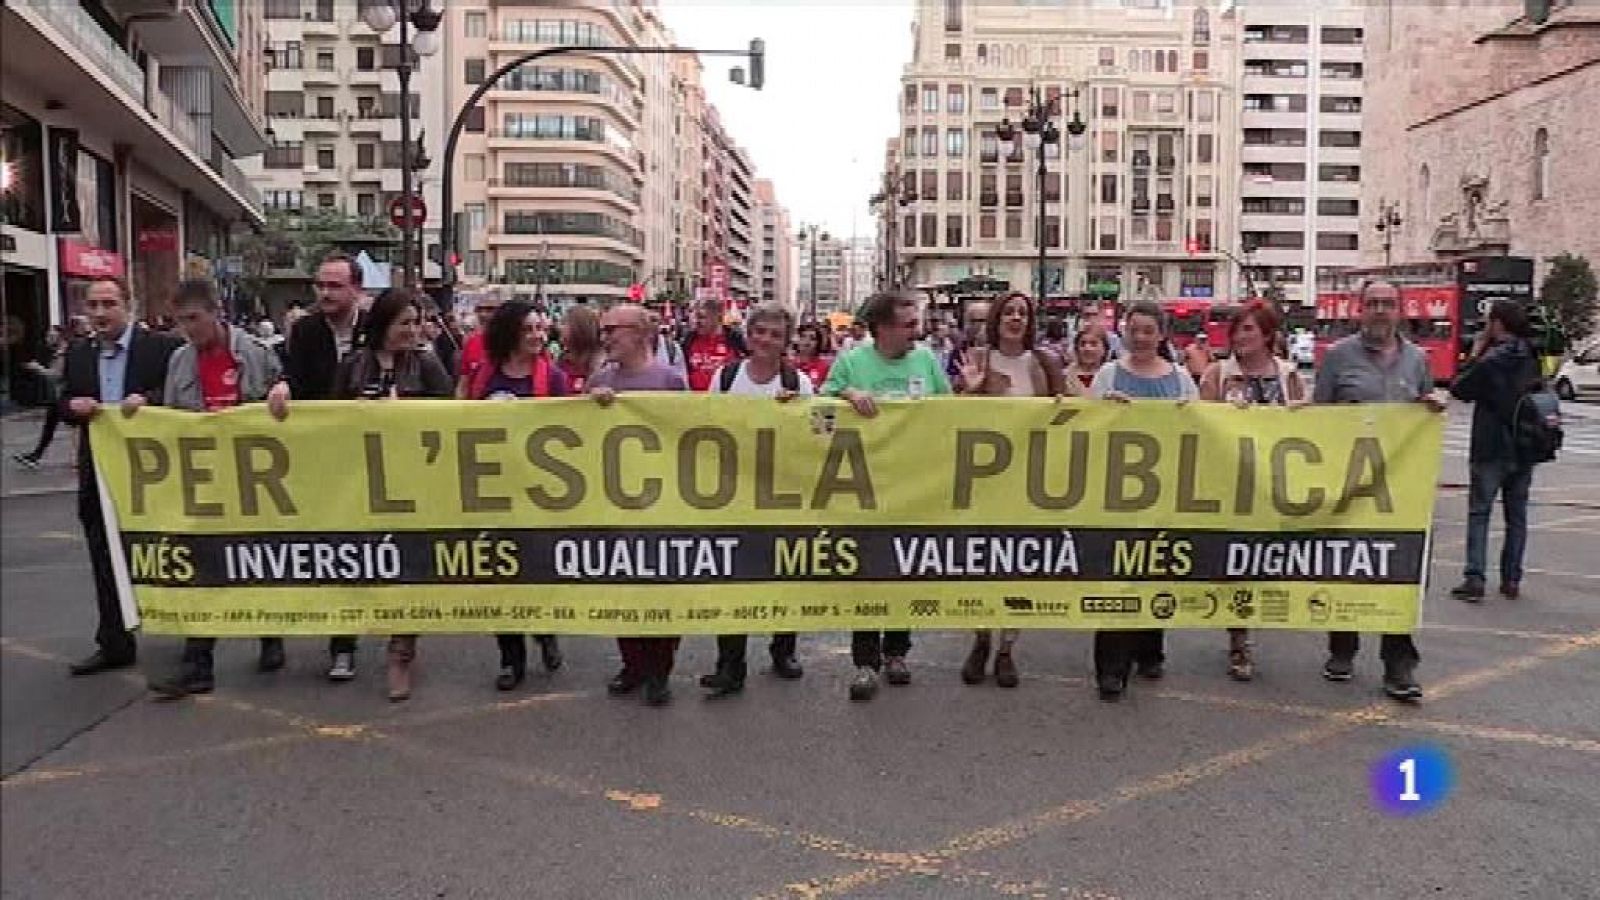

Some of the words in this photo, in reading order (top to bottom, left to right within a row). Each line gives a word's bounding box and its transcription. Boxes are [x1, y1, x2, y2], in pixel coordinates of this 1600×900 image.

[125, 435, 297, 516] PER
[363, 424, 877, 514] L'ESCOLA
[951, 409, 1393, 517] PÚBLICA
[131, 537, 195, 582] MÉS
[224, 534, 401, 580] INVERSIÓ
[435, 531, 519, 578] MÉS
[554, 536, 739, 578] QUALITAT
[774, 529, 859, 576] MÉS
[893, 530, 1080, 577] VALENCIÀ
[1113, 531, 1193, 577] MÉS
[1226, 540, 1396, 577] DIGNITAT
